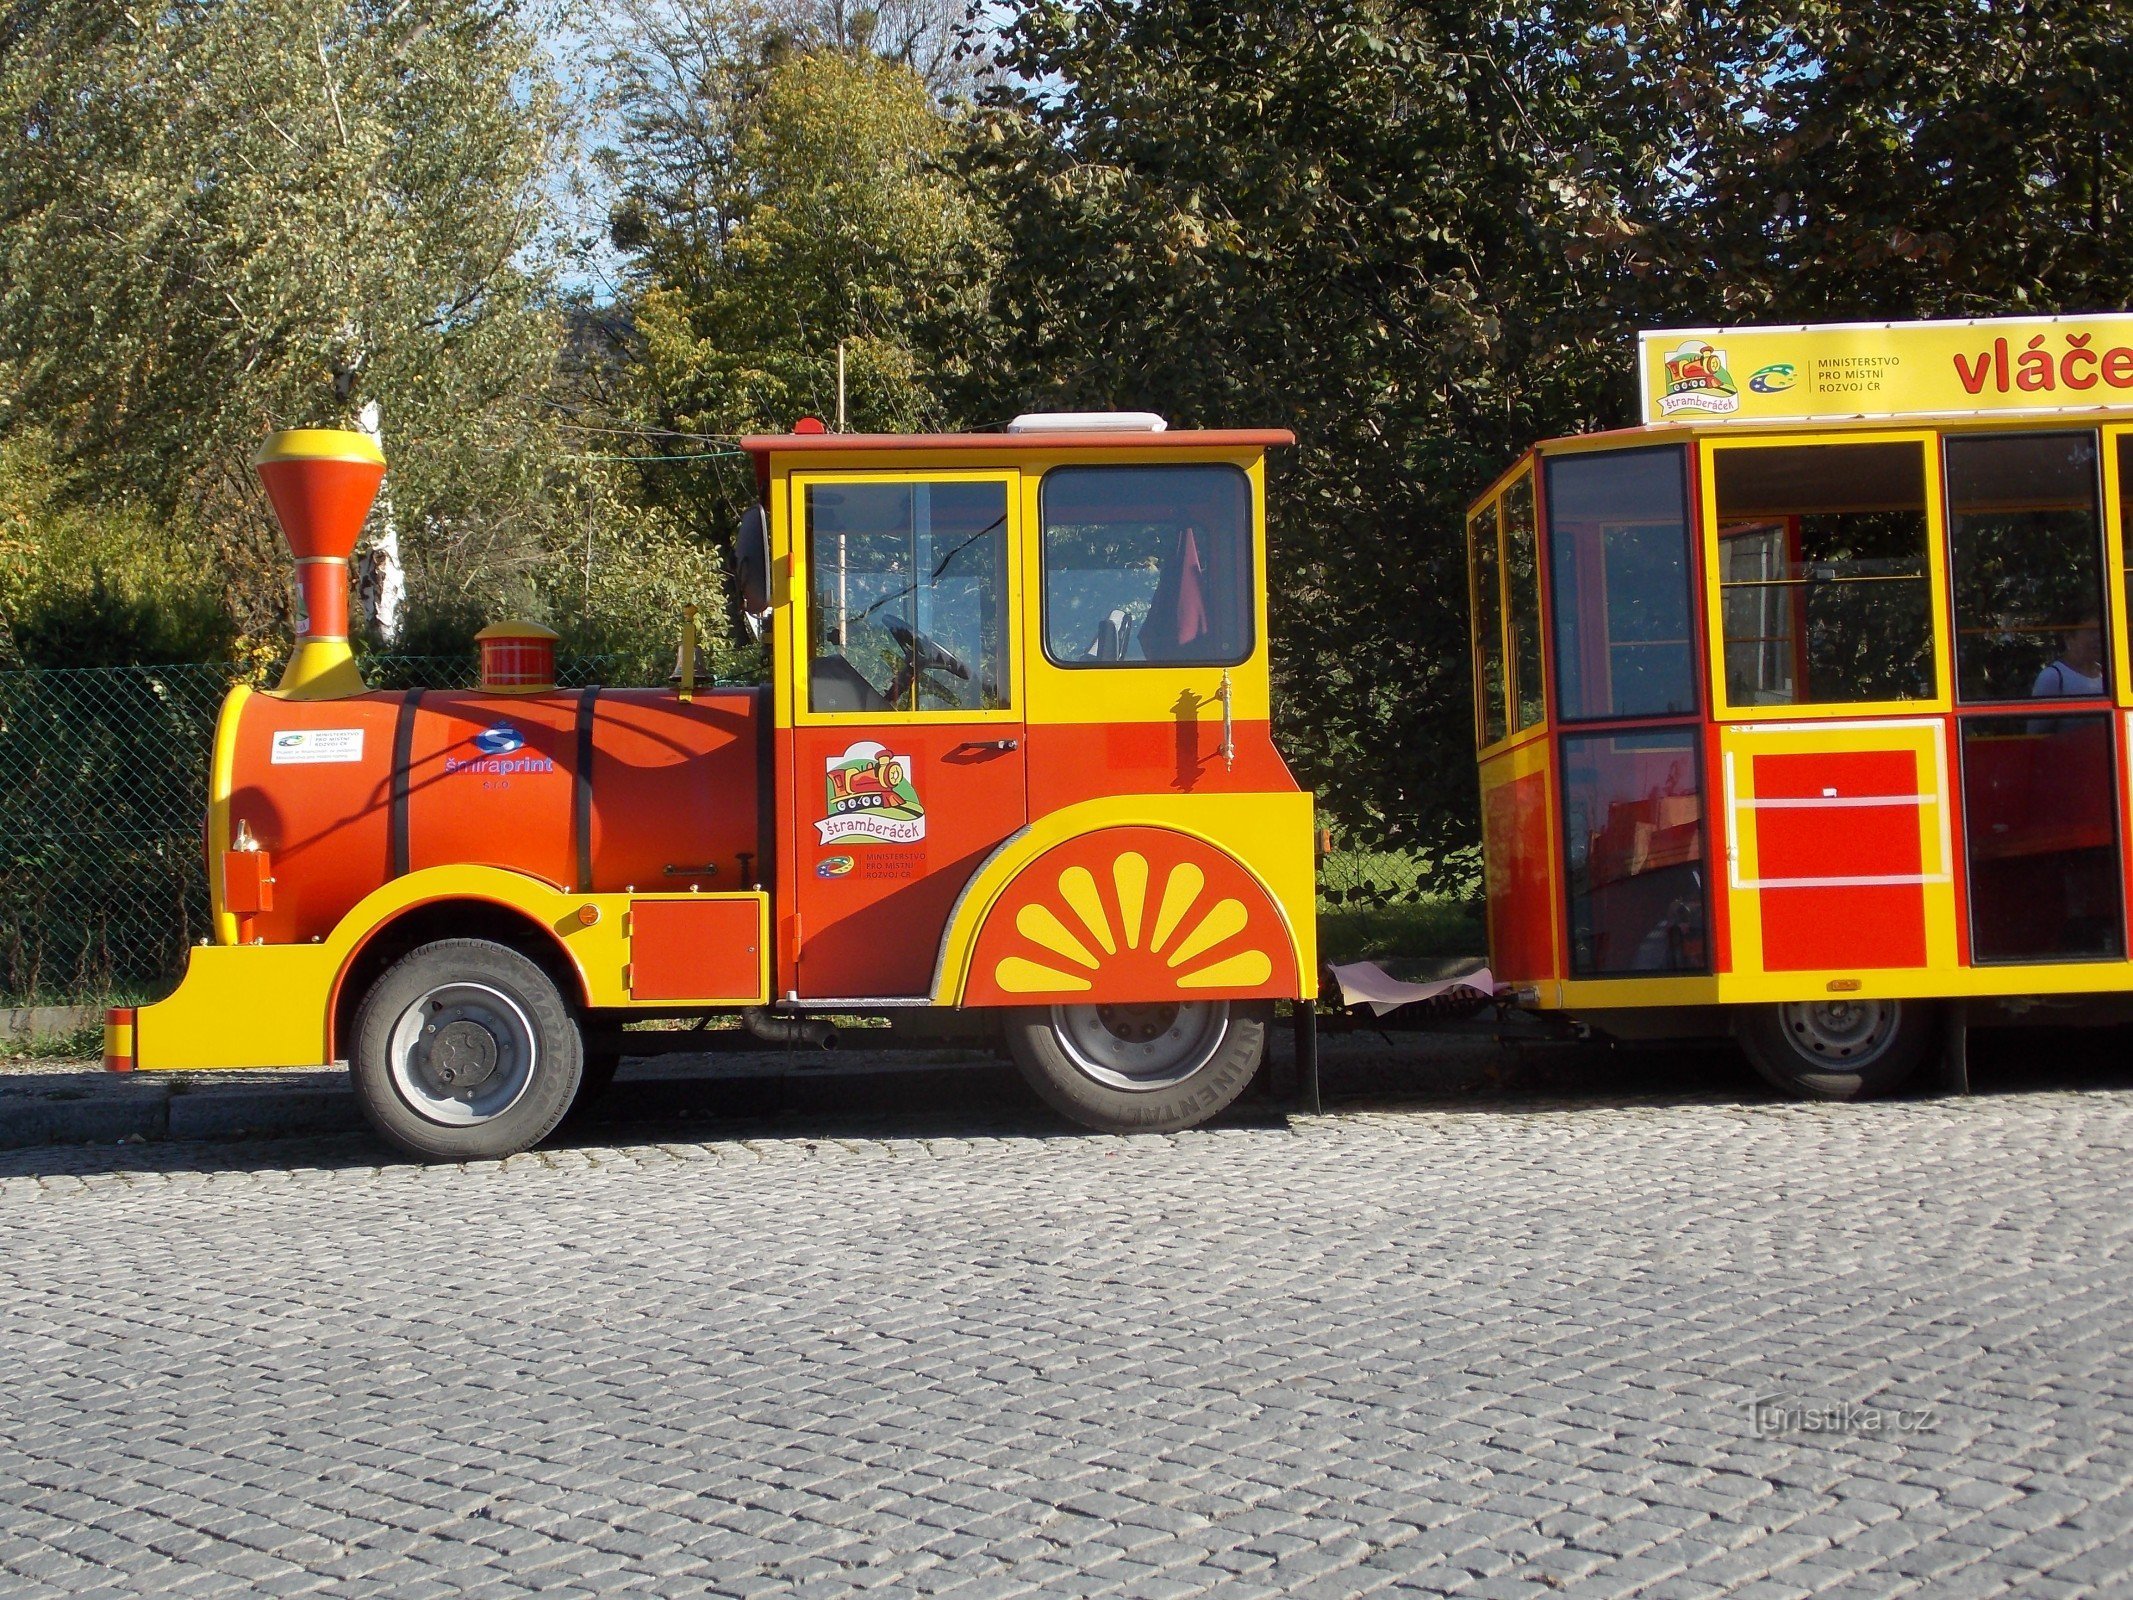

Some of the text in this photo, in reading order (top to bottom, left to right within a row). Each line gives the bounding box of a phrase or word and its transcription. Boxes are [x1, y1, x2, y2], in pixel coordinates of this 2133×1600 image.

[1818, 357, 1900, 368] MINISTERSTVO
[1953, 332, 2133, 394] vláče
[1818, 369, 1884, 380] PRO MÍSTNÍ
[1819, 381, 1881, 392] ROZVOJ ČR
[1665, 395, 1734, 411] štramberáček
[825, 818, 920, 839] štramberáček
[866, 871, 898, 879] ROZVOJ
